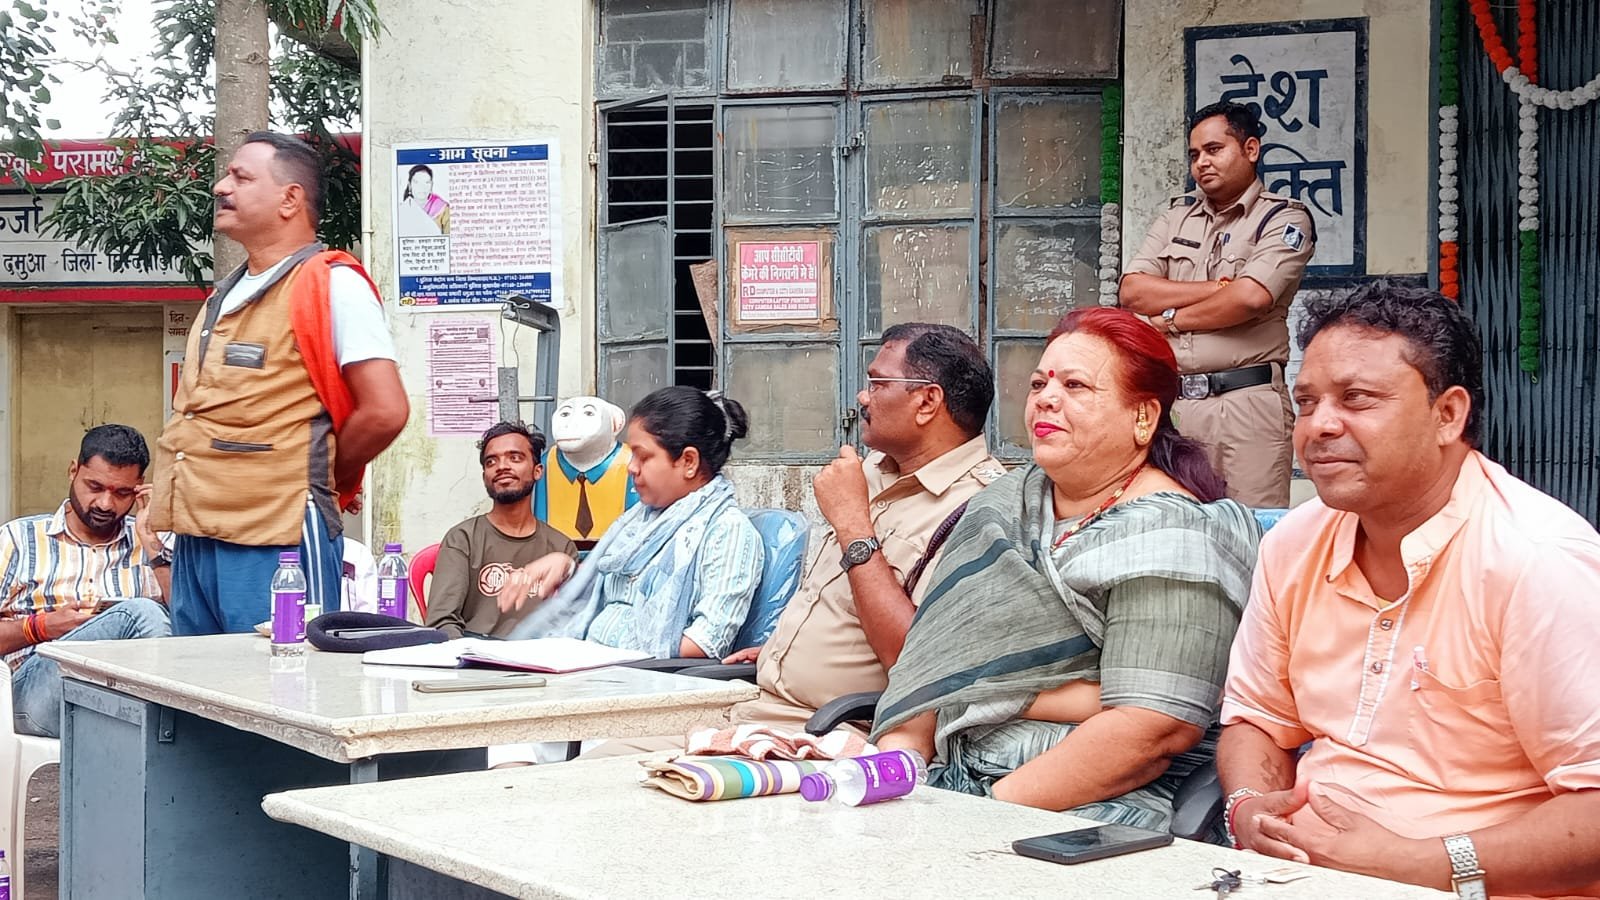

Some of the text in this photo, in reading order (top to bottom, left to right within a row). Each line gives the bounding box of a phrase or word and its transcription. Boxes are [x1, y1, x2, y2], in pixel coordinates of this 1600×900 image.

[1219, 54, 1329, 138] देश
[438, 147, 508, 163] आम सूचना
[1257, 143, 1347, 218] क्ति
[3, 253, 46, 280] दमुआ
